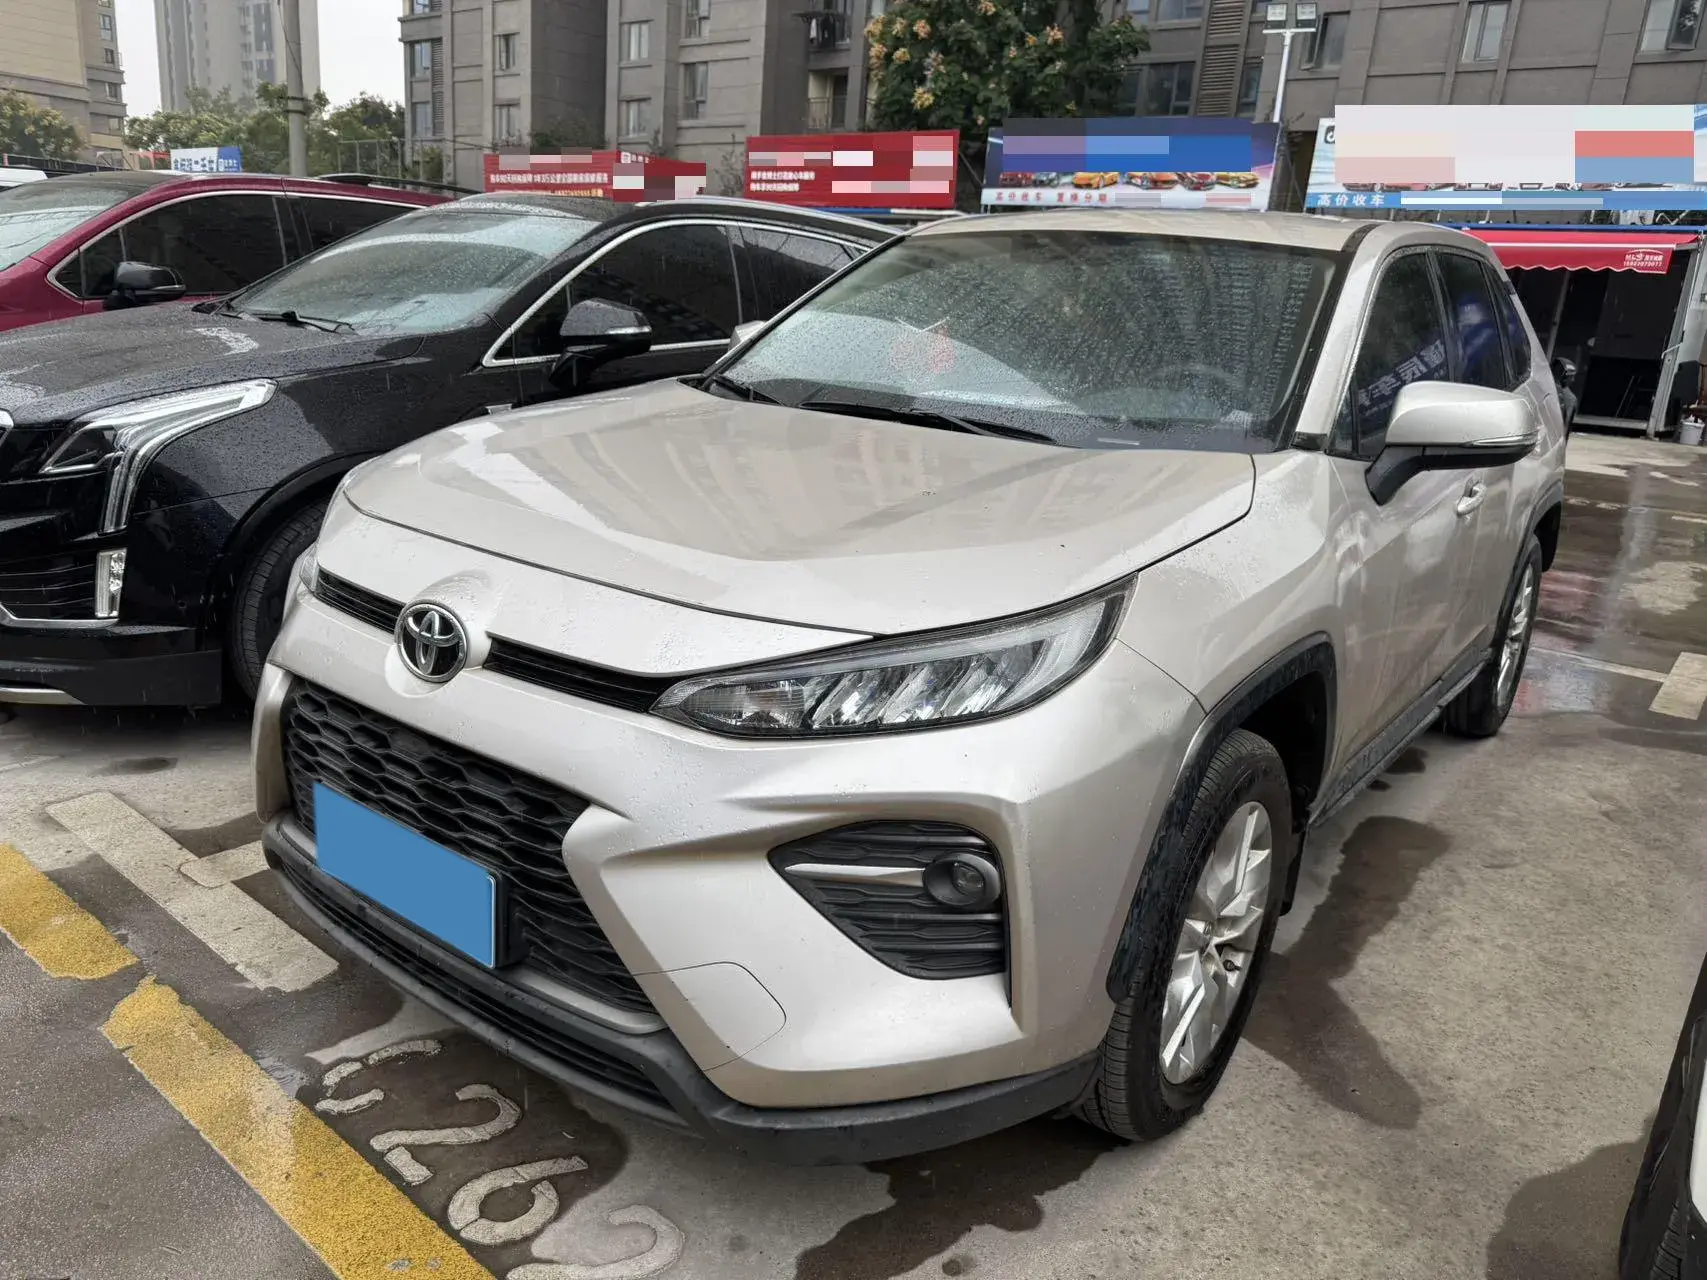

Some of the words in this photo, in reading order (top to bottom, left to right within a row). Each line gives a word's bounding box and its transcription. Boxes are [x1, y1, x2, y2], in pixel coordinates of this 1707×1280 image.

[996, 191, 1042, 203] 高价收车
[1317, 193, 1384, 207] 高价收车
